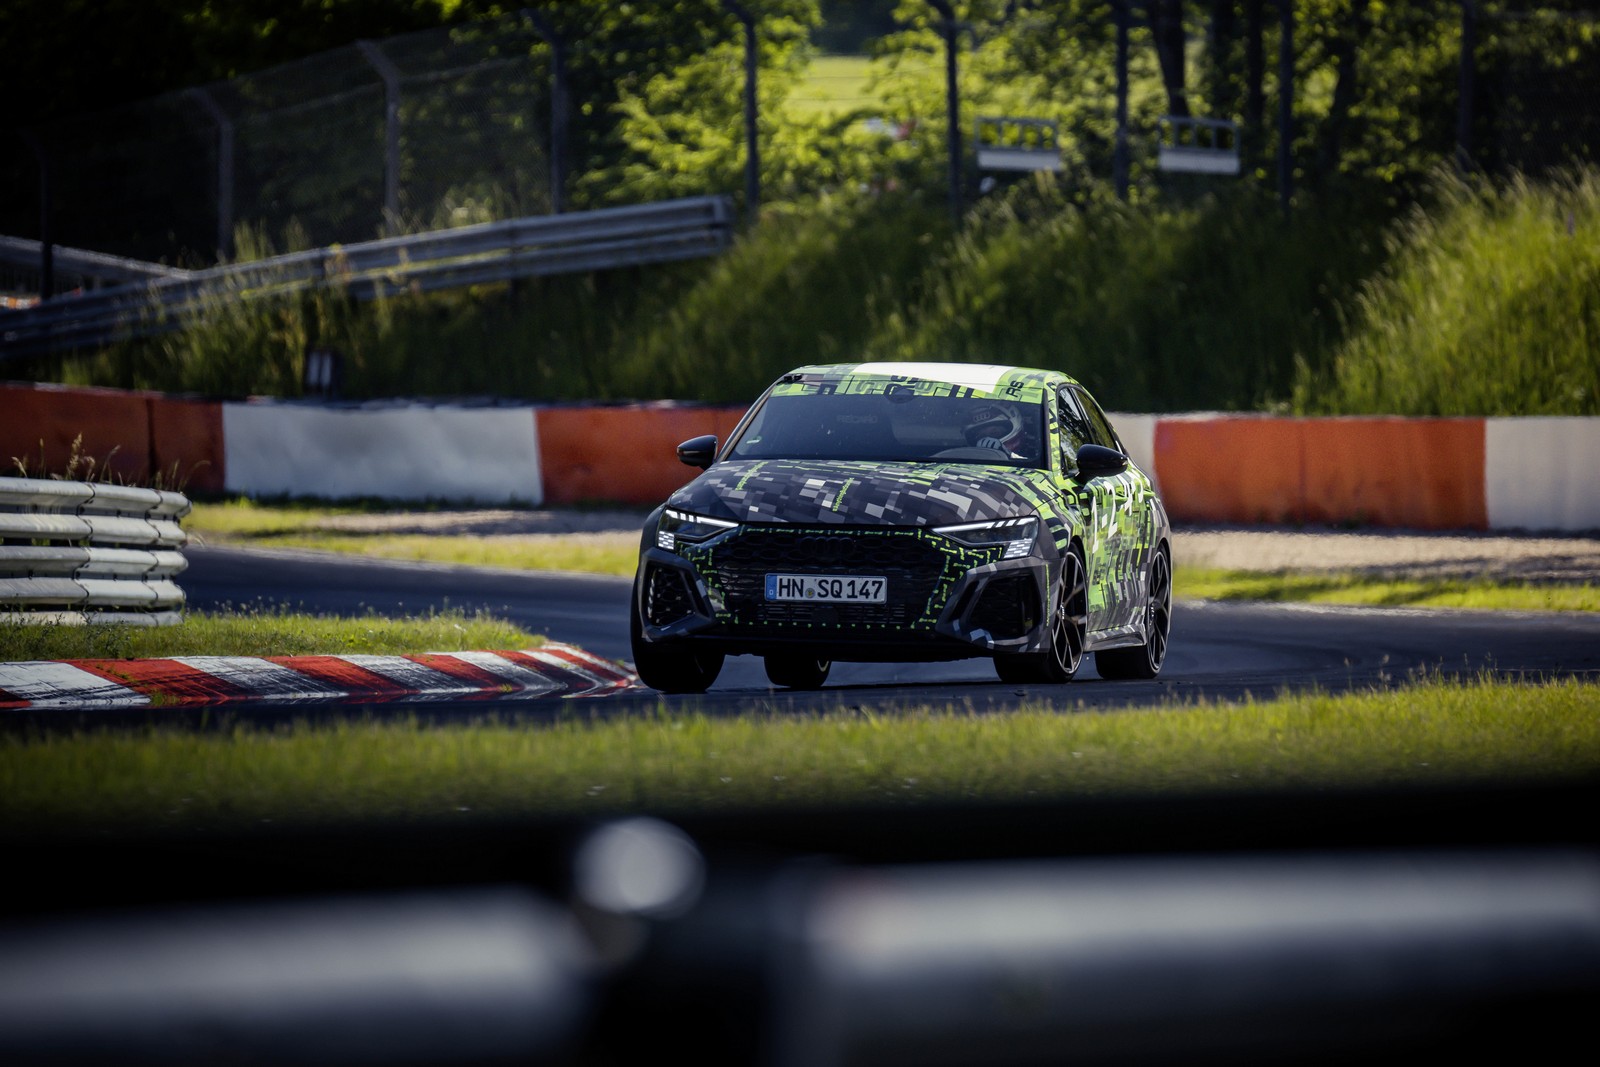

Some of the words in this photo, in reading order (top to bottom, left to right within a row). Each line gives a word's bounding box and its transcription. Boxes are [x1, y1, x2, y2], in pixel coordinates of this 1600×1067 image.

[1006, 381, 1024, 397] RS
[778, 578, 805, 598] HN
[817, 579, 843, 598] SQ
[847, 580, 884, 599] 147
